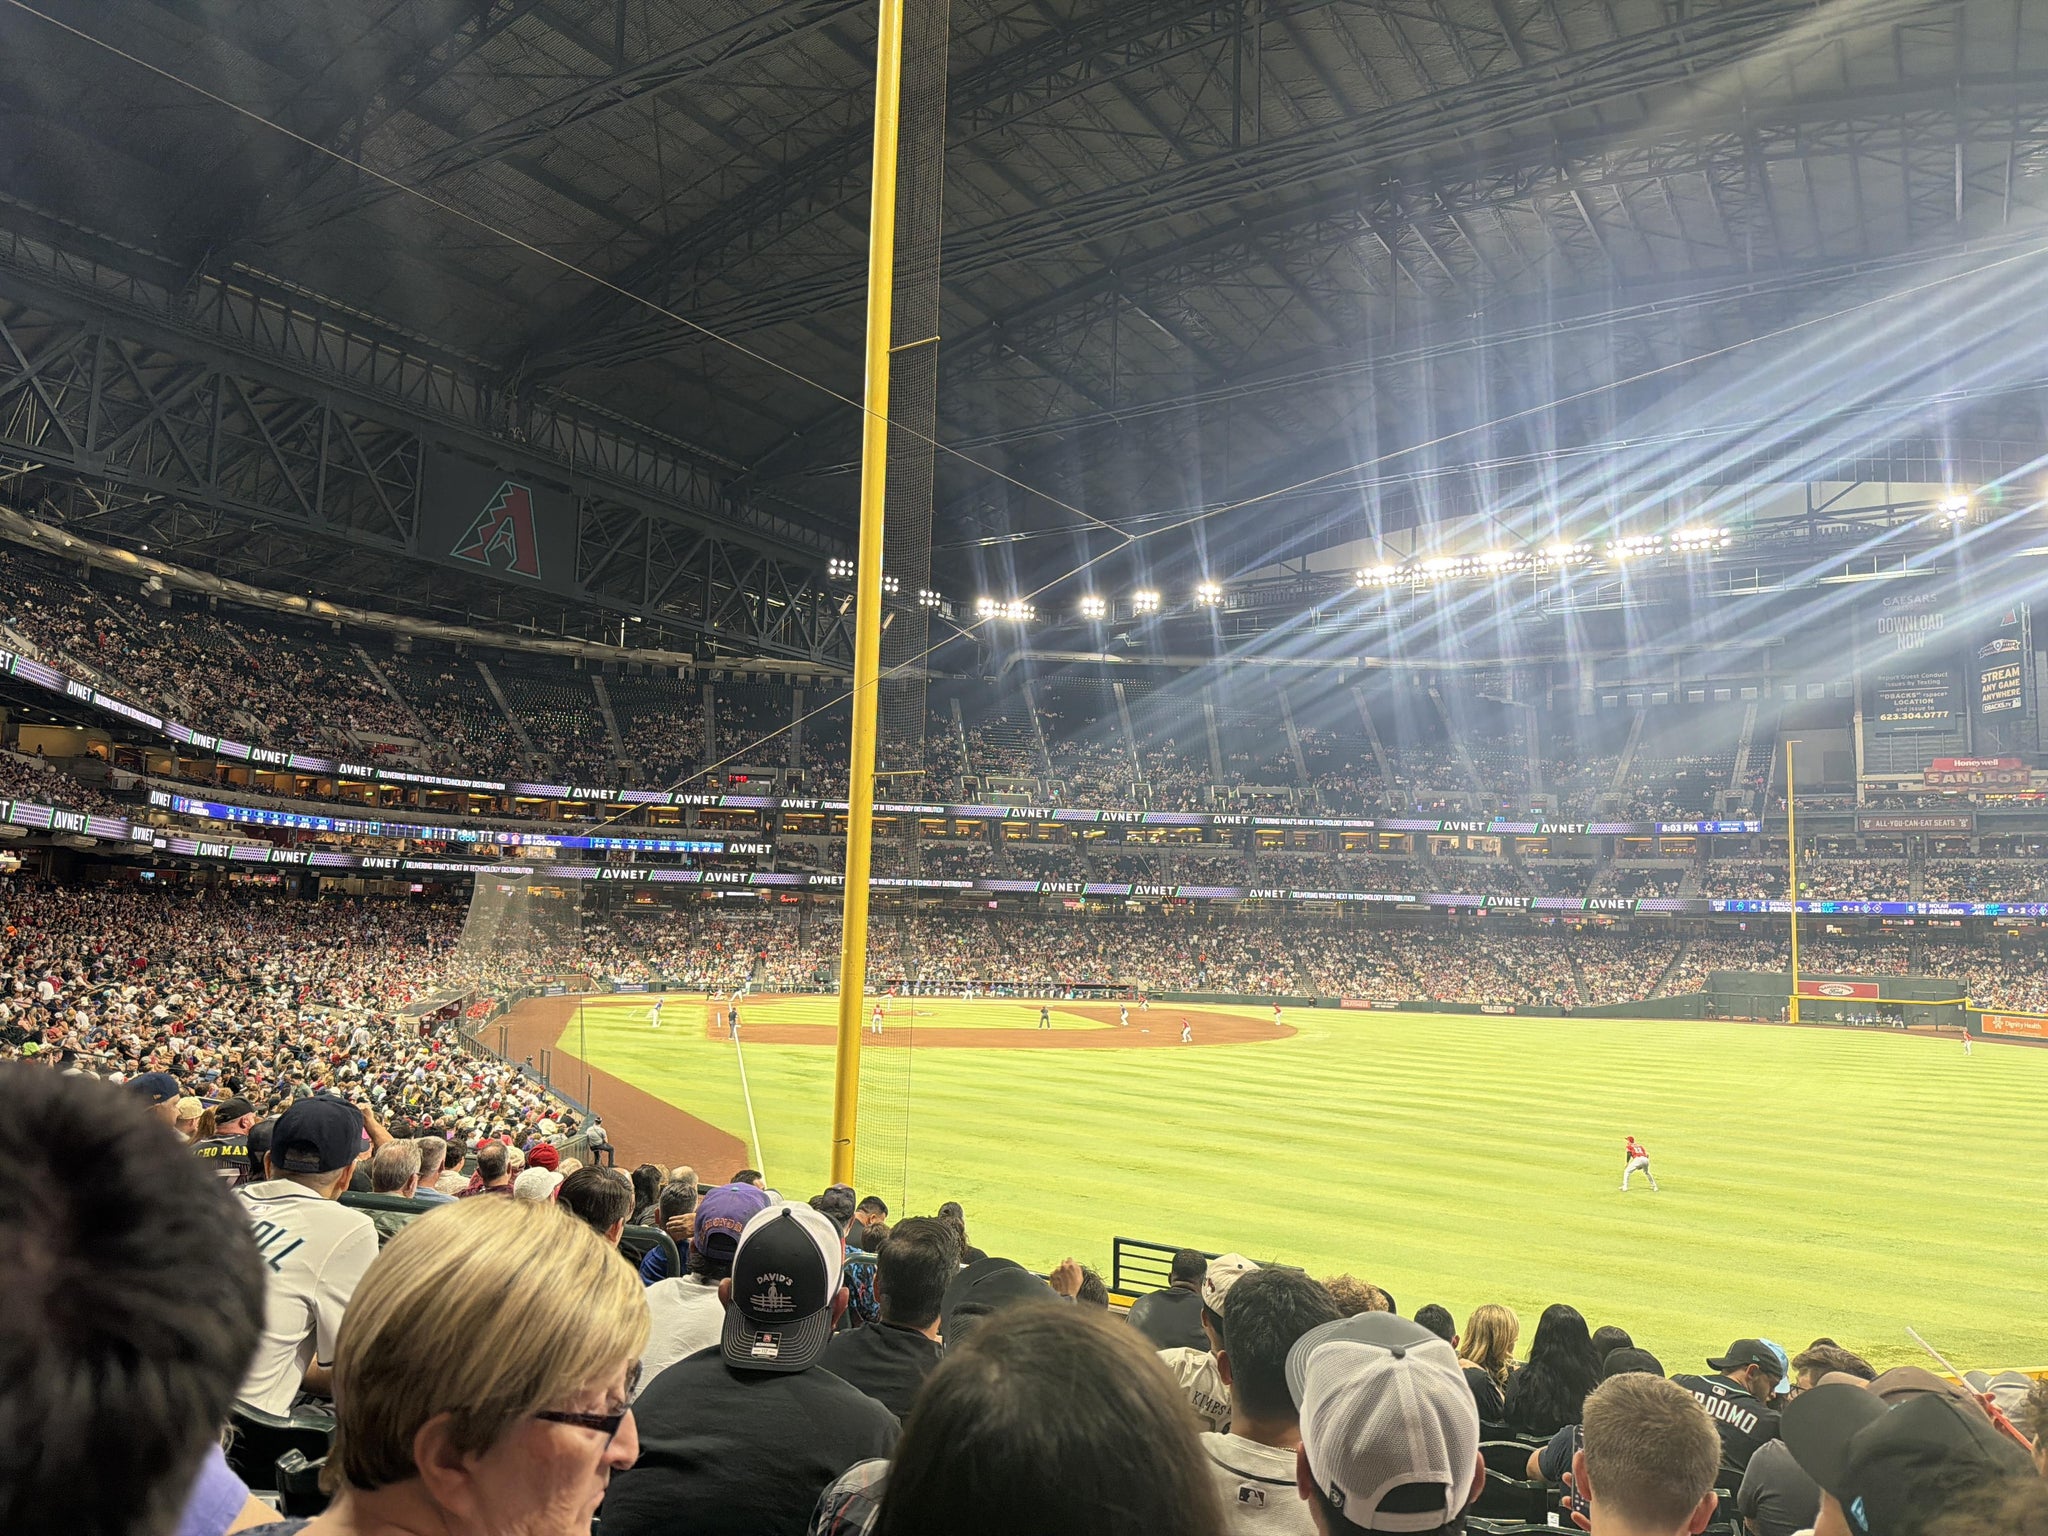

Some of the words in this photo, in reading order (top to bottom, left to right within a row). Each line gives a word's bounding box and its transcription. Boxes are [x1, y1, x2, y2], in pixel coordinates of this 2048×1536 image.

[1882, 593, 1937, 606] CAESARS
[1878, 613, 1944, 634] DOWNLOAD
[1897, 631, 1925, 649] NOW
[1981, 666, 2020, 684] STREAM
[67, 680, 93, 702] AVNET
[1982, 683, 1996, 693] ANY
[1998, 678, 2020, 690] GAME
[1982, 687, 2021, 702] ANYWHERE
[1894, 698, 1934, 706] LOCATION
[1880, 711, 1949, 721] 623.304.0777
[192, 733, 217, 750] AVNET
[252, 748, 288, 764] AVNET
[1954, 759, 1998, 767] Honeywell
[339, 763, 374, 777] AVNET
[1928, 771, 2026, 785] SANDLOT
[151, 790, 171, 807] AVNET
[573, 788, 617, 800] AVNET
[675, 794, 719, 805] AVNET
[781, 799, 818, 809] AVNET
[1012, 808, 1050, 818] AVNET
[1102, 812, 1141, 822] AVNET
[54, 810, 86, 831] AVNET
[1213, 815, 1248, 825] AVNET
[1934, 819, 1955, 827] SEATS
[1444, 821, 1485, 831] AVNET
[1541, 823, 1584, 834] AVNET
[1661, 824, 1681, 832] 8:03
[1683, 824, 1698, 832] PM
[132, 826, 155, 841] AVNET
[200, 842, 230, 857] AVNET
[730, 843, 772, 854] AVNET
[272, 850, 307, 863] AVNET
[362, 857, 400, 868] AVNET
[602, 869, 647, 880] AVNET
[705, 872, 748, 883] AVNET
[809, 875, 845, 885] AVNET
[1042, 882, 1082, 892] AVNET
[1134, 885, 1175, 895] AVNET
[1250, 890, 1286, 899] AVNET
[1488, 897, 1530, 907] AVNET
[1590, 899, 1634, 909] AVNET
[756, 1272, 794, 1287] DAVID'S
